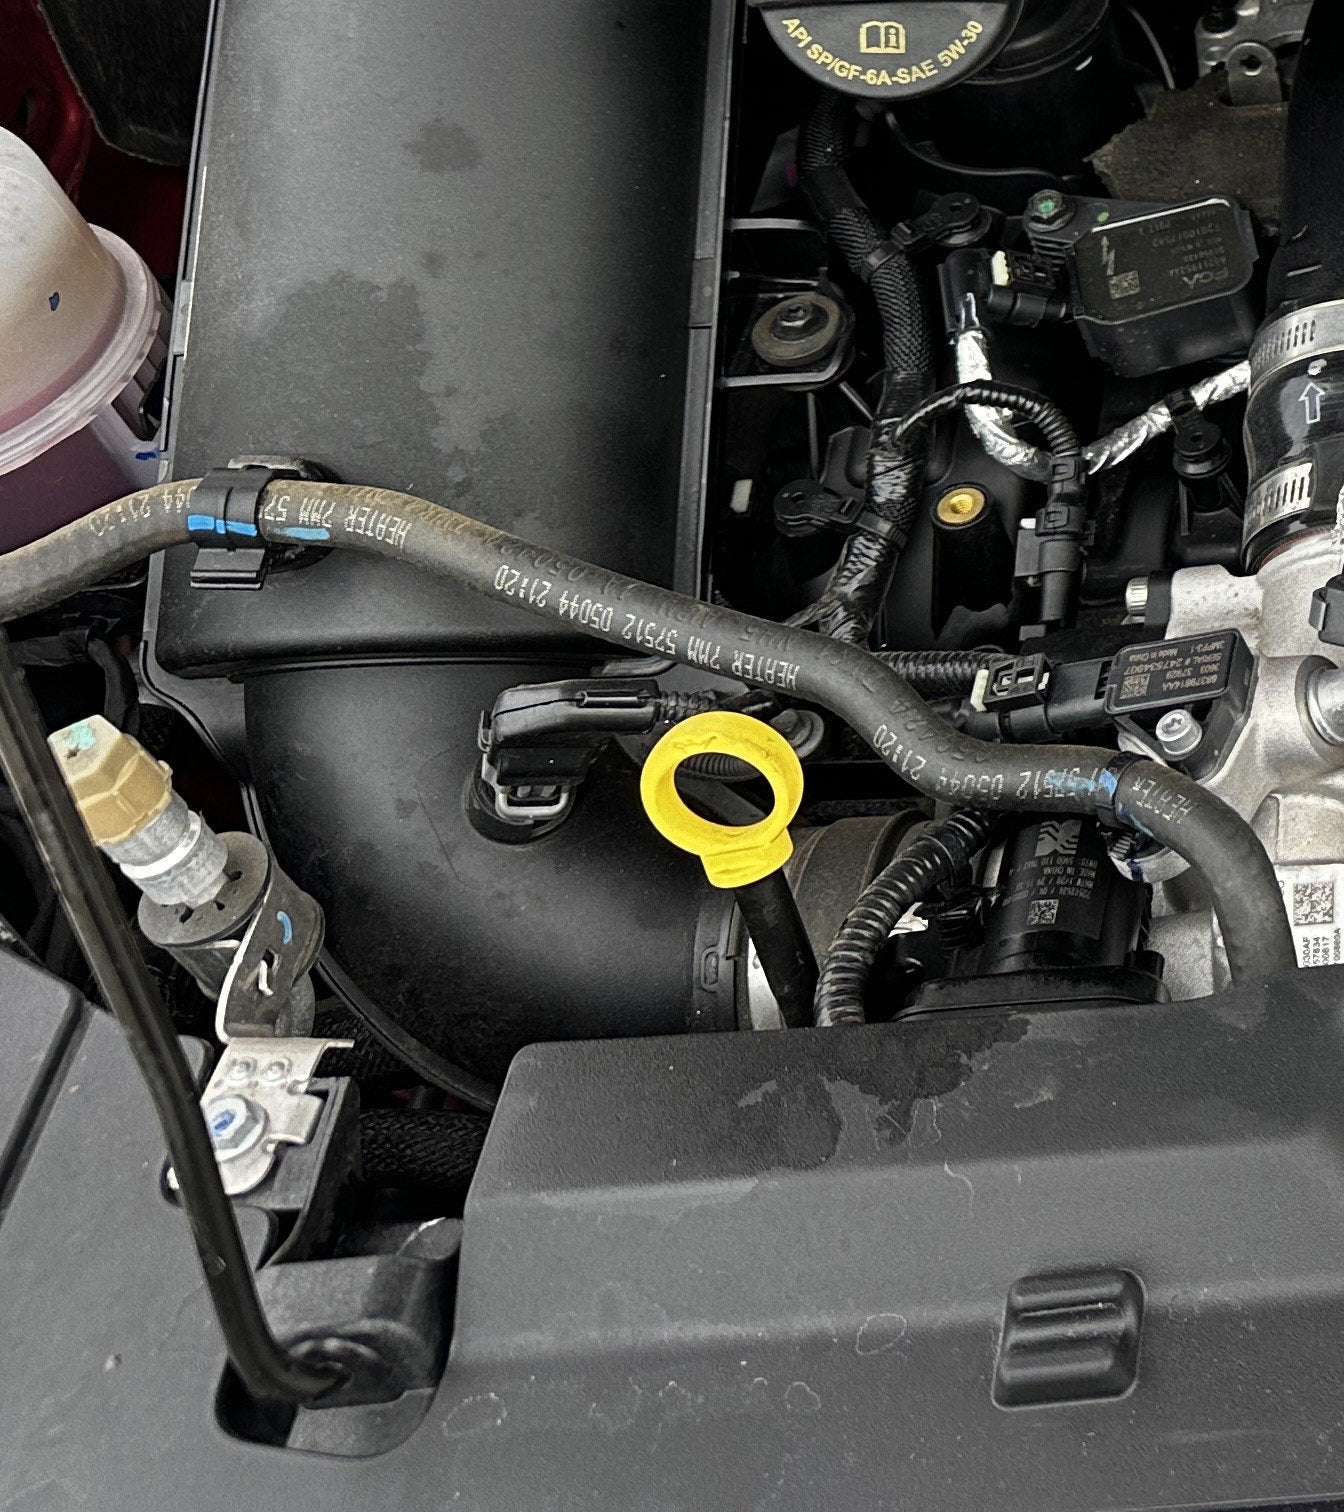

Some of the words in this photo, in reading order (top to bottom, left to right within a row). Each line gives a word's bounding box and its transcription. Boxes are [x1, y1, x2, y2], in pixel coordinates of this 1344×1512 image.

[781, 18, 812, 49] API
[806, 43, 938, 86] SP/GF-6A-SAE
[937, 20, 984, 67] 5W-30
[298, 496, 332, 527] 7MM
[342, 503, 410, 548] HEATER
[558, 590, 614, 632] 05044
[621, 613, 678, 655] 57512
[686, 635, 721, 669] 7MM
[731, 649, 800, 690] HEATER
[1130, 776, 1194, 825] HEATER
